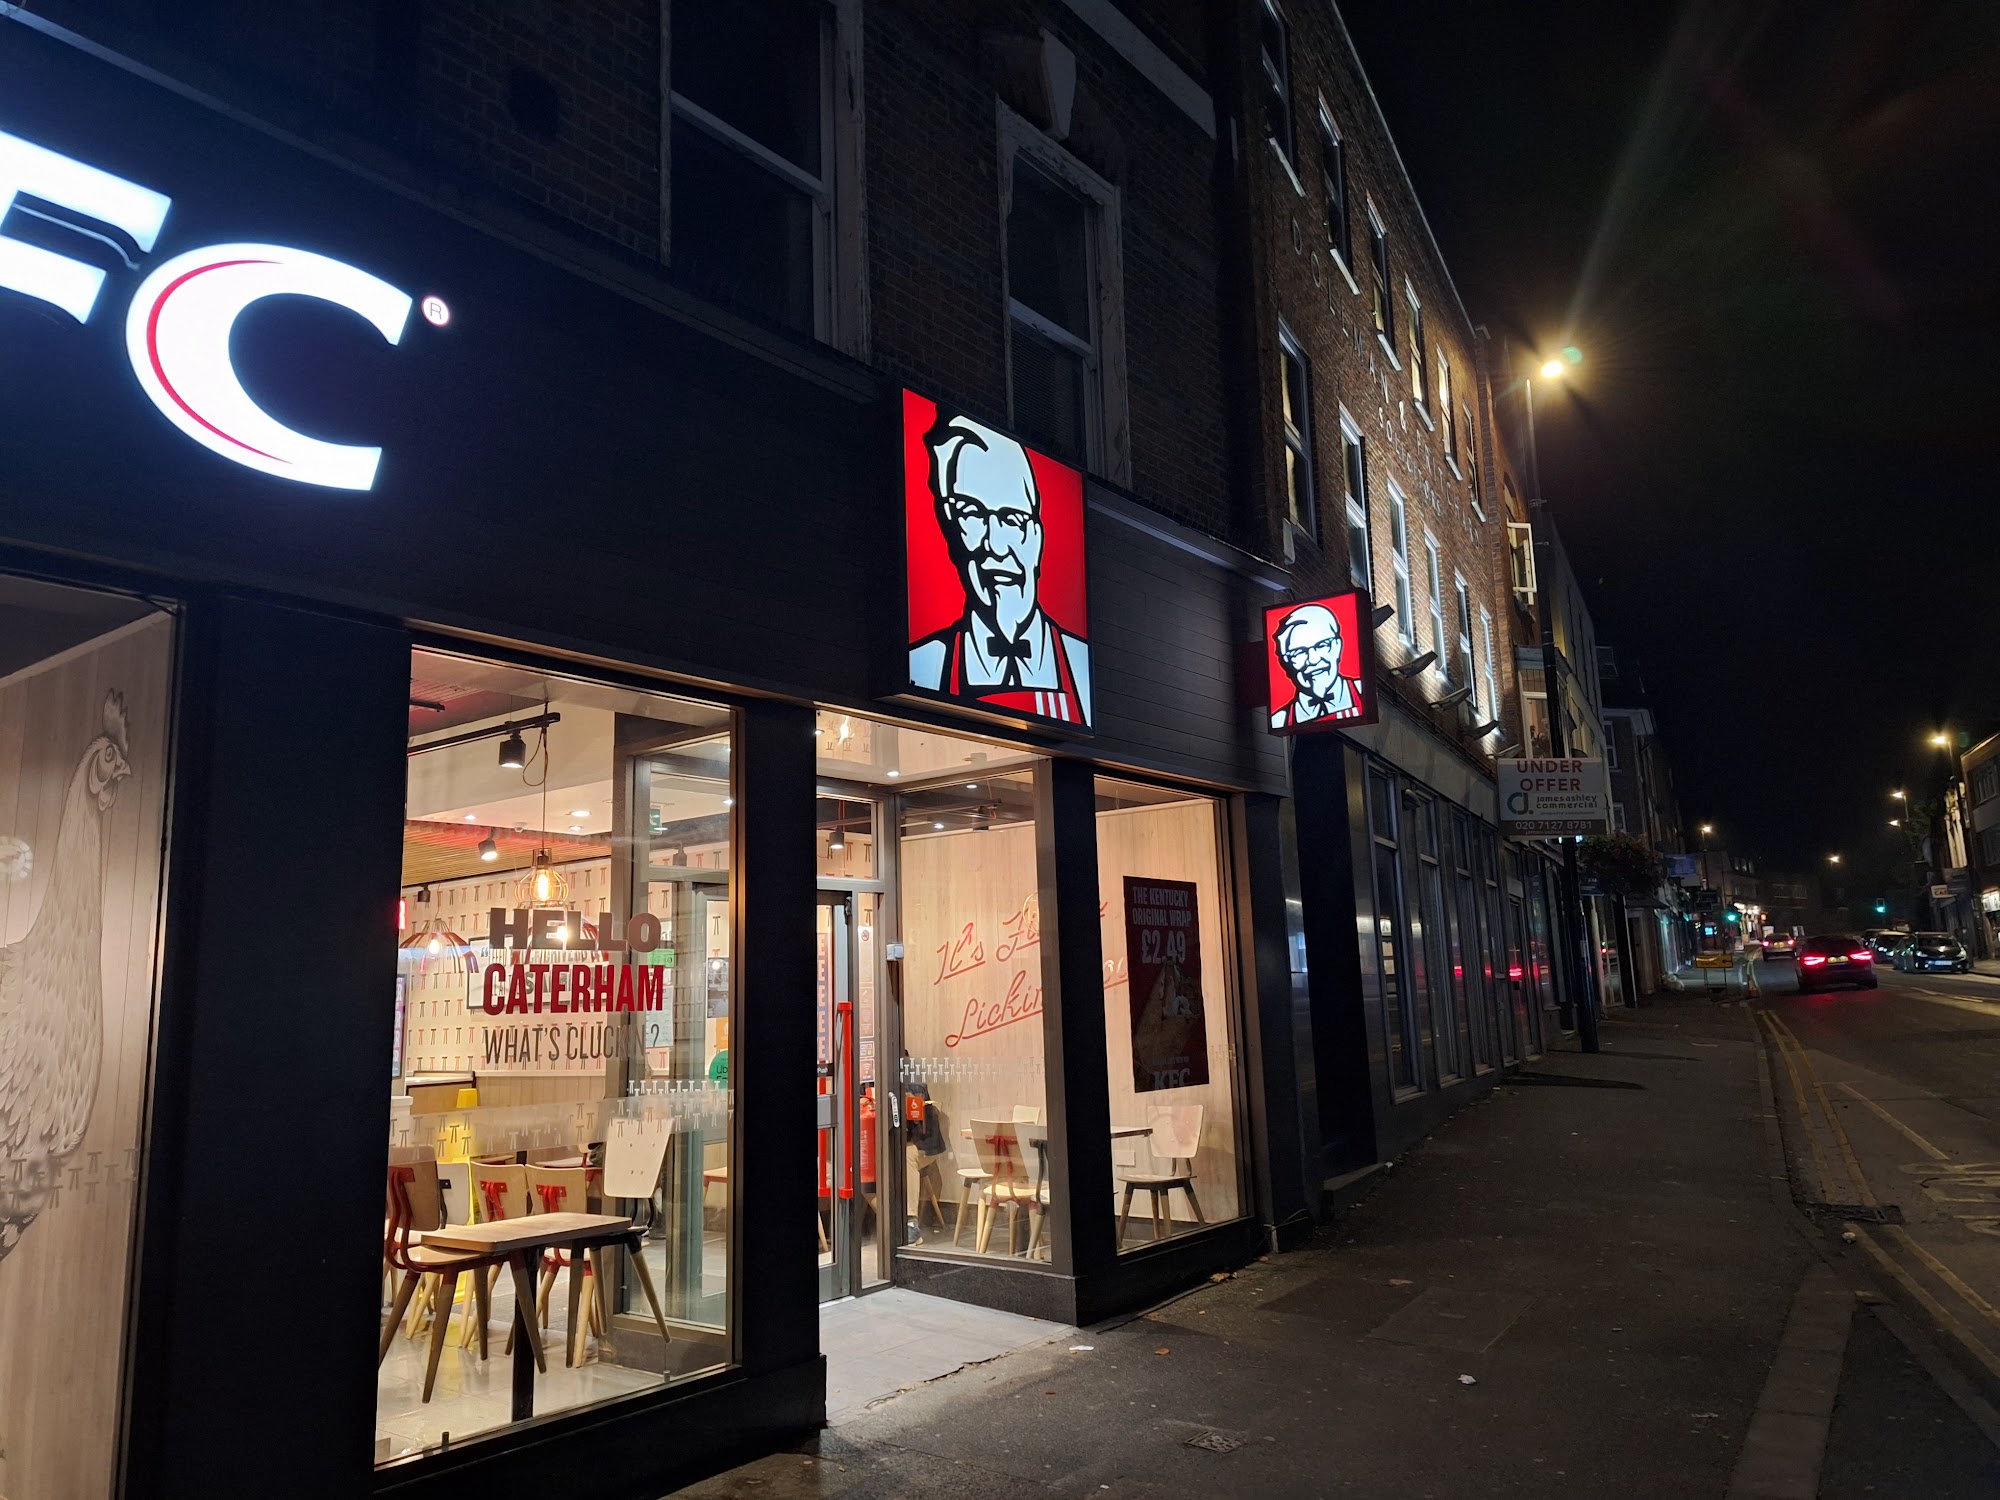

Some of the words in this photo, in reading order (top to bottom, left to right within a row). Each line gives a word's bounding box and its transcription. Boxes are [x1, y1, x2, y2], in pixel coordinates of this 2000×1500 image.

[1516, 761, 1583, 773] UNDER
[1520, 779, 1581, 791] OFFER
[1515, 821, 1535, 830] 020
[1538, 821, 1563, 830] 7127
[1567, 820, 1593, 830] 8781
[1133, 887, 1148, 905] THE
[1149, 888, 1189, 907] KENTUCKY
[1132, 907, 1168, 926] ORIGINAL
[1169, 910, 1192, 927] WRAP
[489, 907, 662, 953] HELLO
[1141, 929, 1186, 964] £2.49
[482, 963, 666, 1016] CATERHAM
[484, 1025, 561, 1064] WHAT'S
